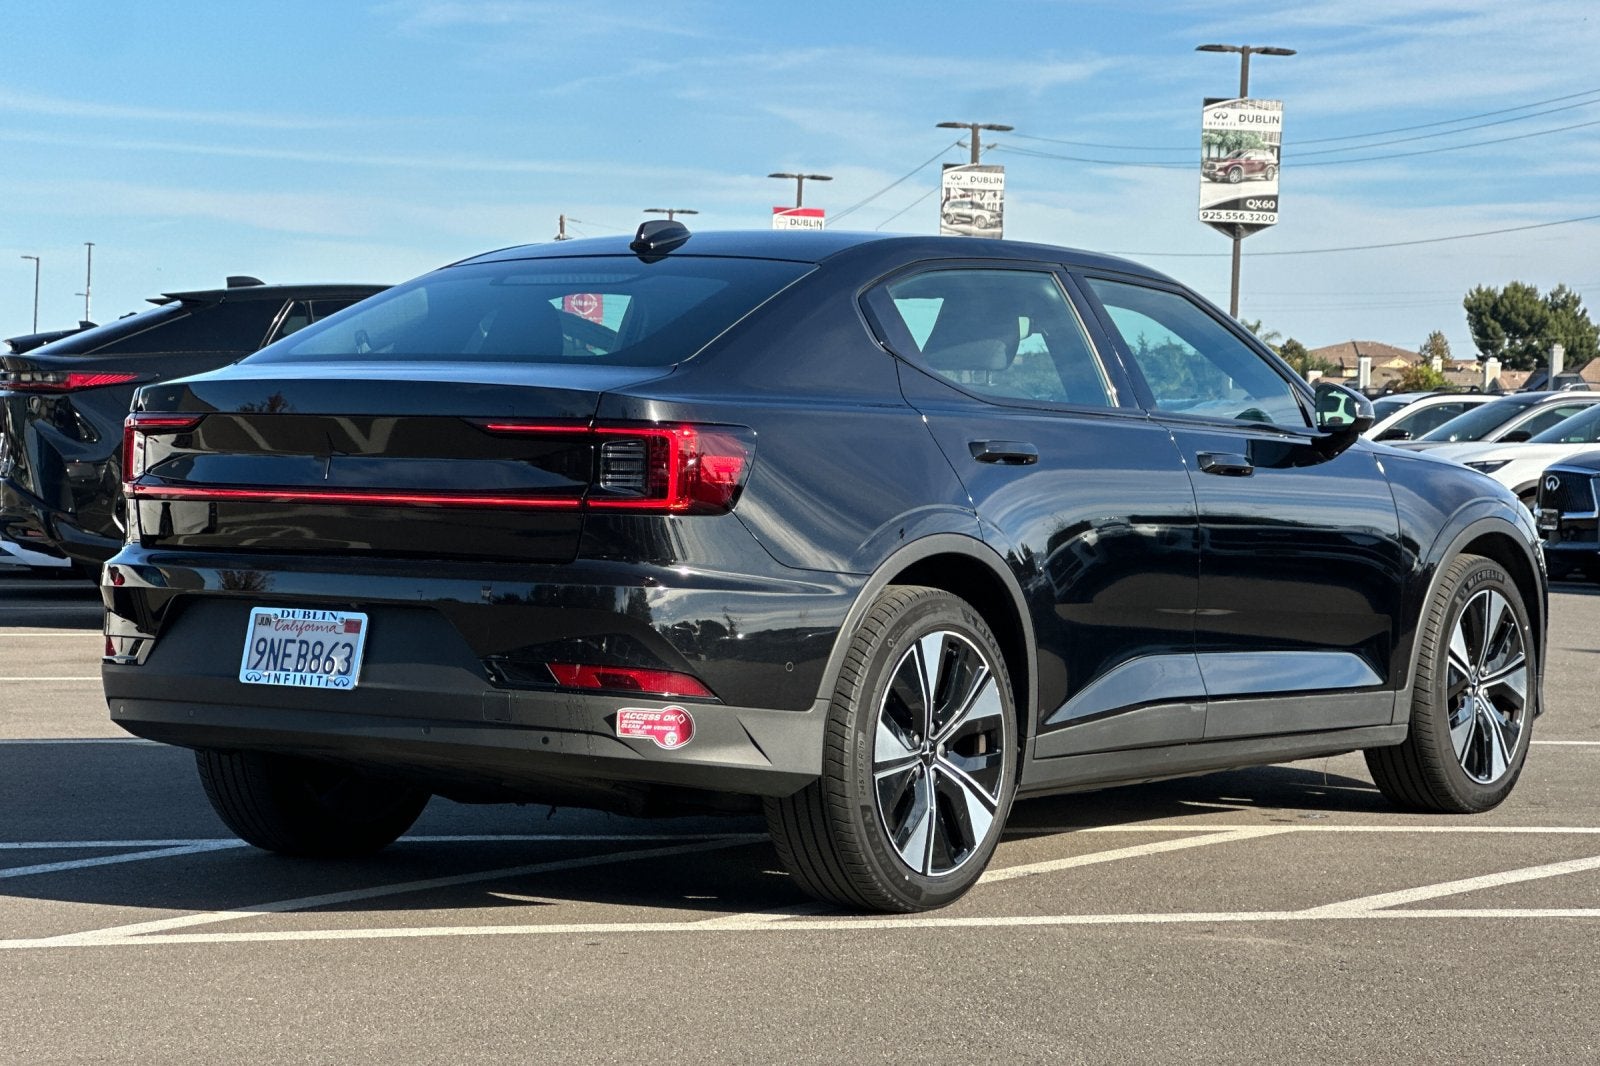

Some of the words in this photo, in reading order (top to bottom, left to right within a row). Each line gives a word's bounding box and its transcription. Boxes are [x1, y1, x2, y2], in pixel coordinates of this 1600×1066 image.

[1239, 114, 1280, 124] DUBLIN
[970, 175, 1002, 184] DUBLIN
[1246, 199, 1276, 210] QX60
[1202, 212, 1275, 222] 925.556.3200
[790, 218, 823, 229] DUBLIN
[1467, 569, 1504, 589] MICHELIN
[280, 609, 338, 621] DUBLIN
[258, 617, 272, 626] JUN
[274, 619, 343, 637] California
[252, 637, 354, 676] 9NEB863
[266, 673, 330, 687] INFINITI
[622, 712, 661, 721] ACCESS
[663, 714, 678, 722] OK
